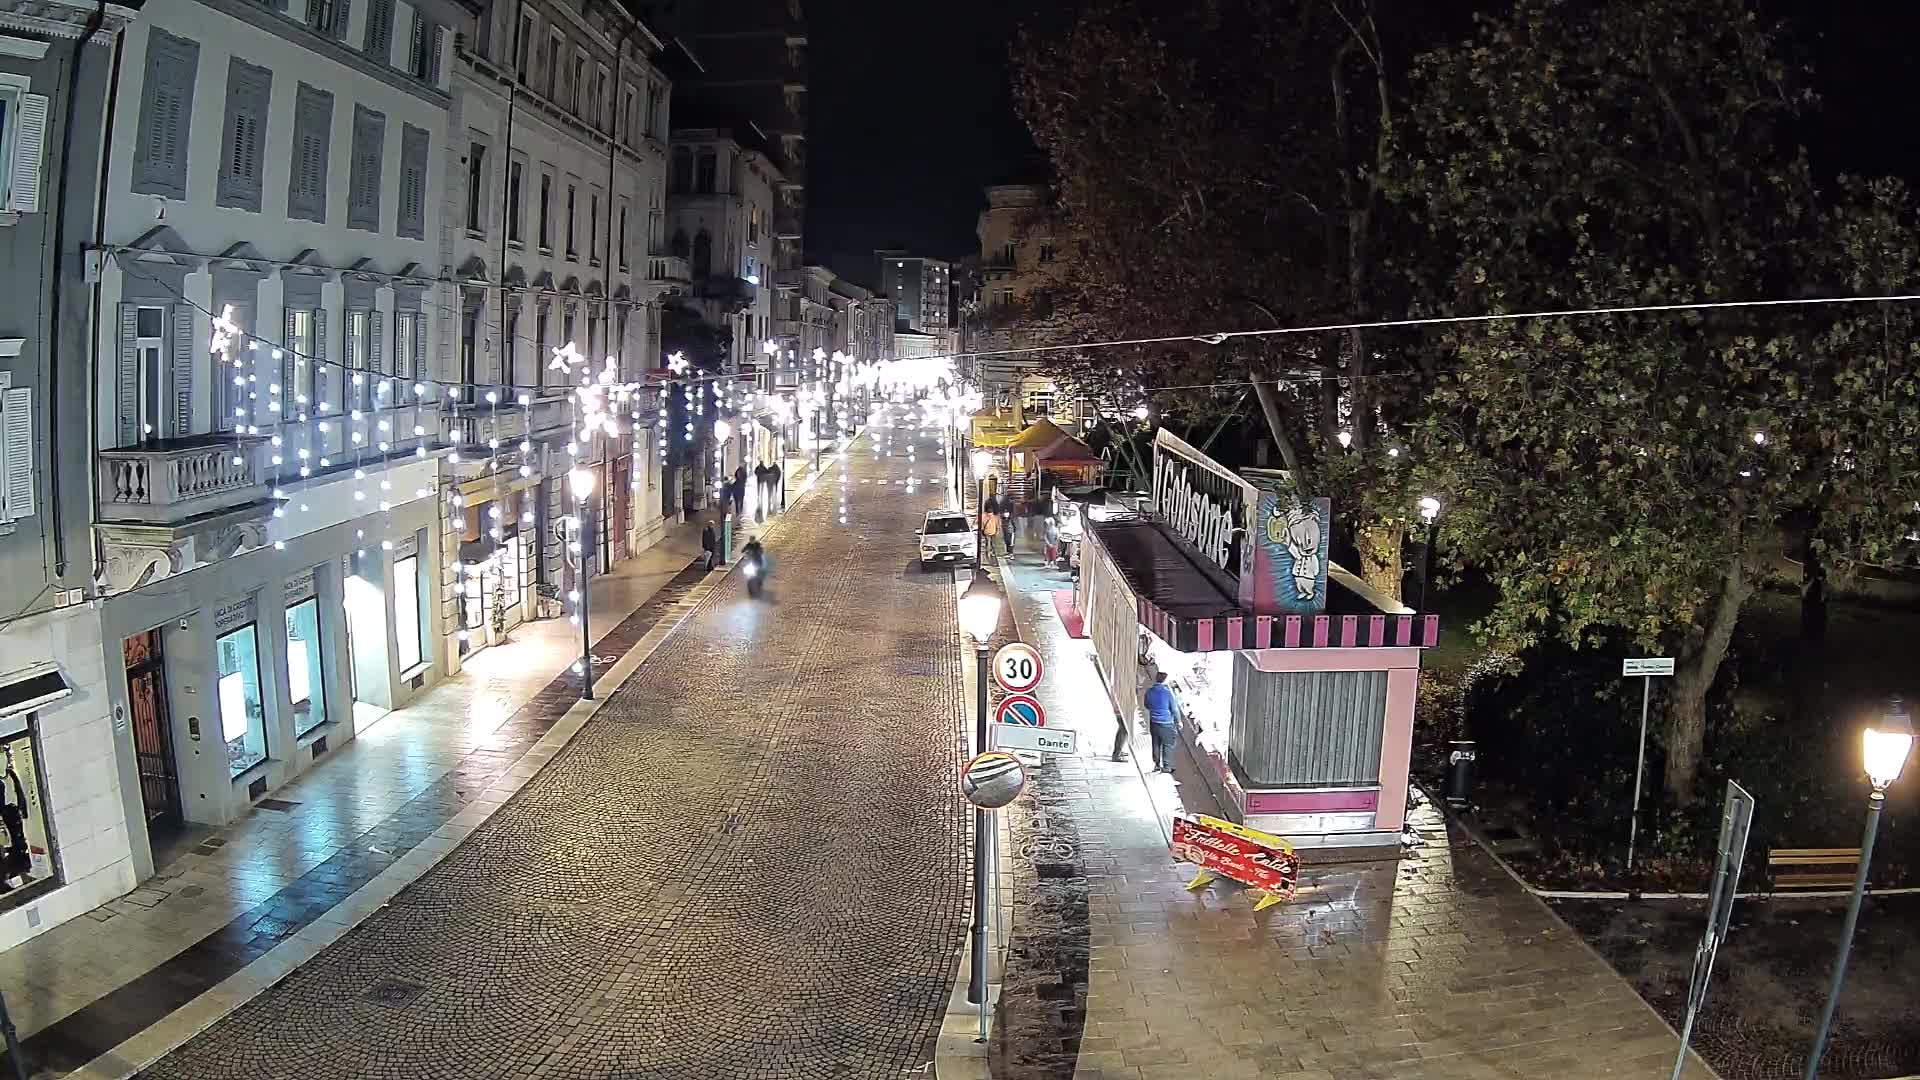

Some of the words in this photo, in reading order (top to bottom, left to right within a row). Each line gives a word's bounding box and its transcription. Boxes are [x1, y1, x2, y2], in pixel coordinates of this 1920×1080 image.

[1162, 458, 1233, 570] Golosone
[1006, 658, 1032, 679] 30
[1038, 737, 1069, 749] Dante
